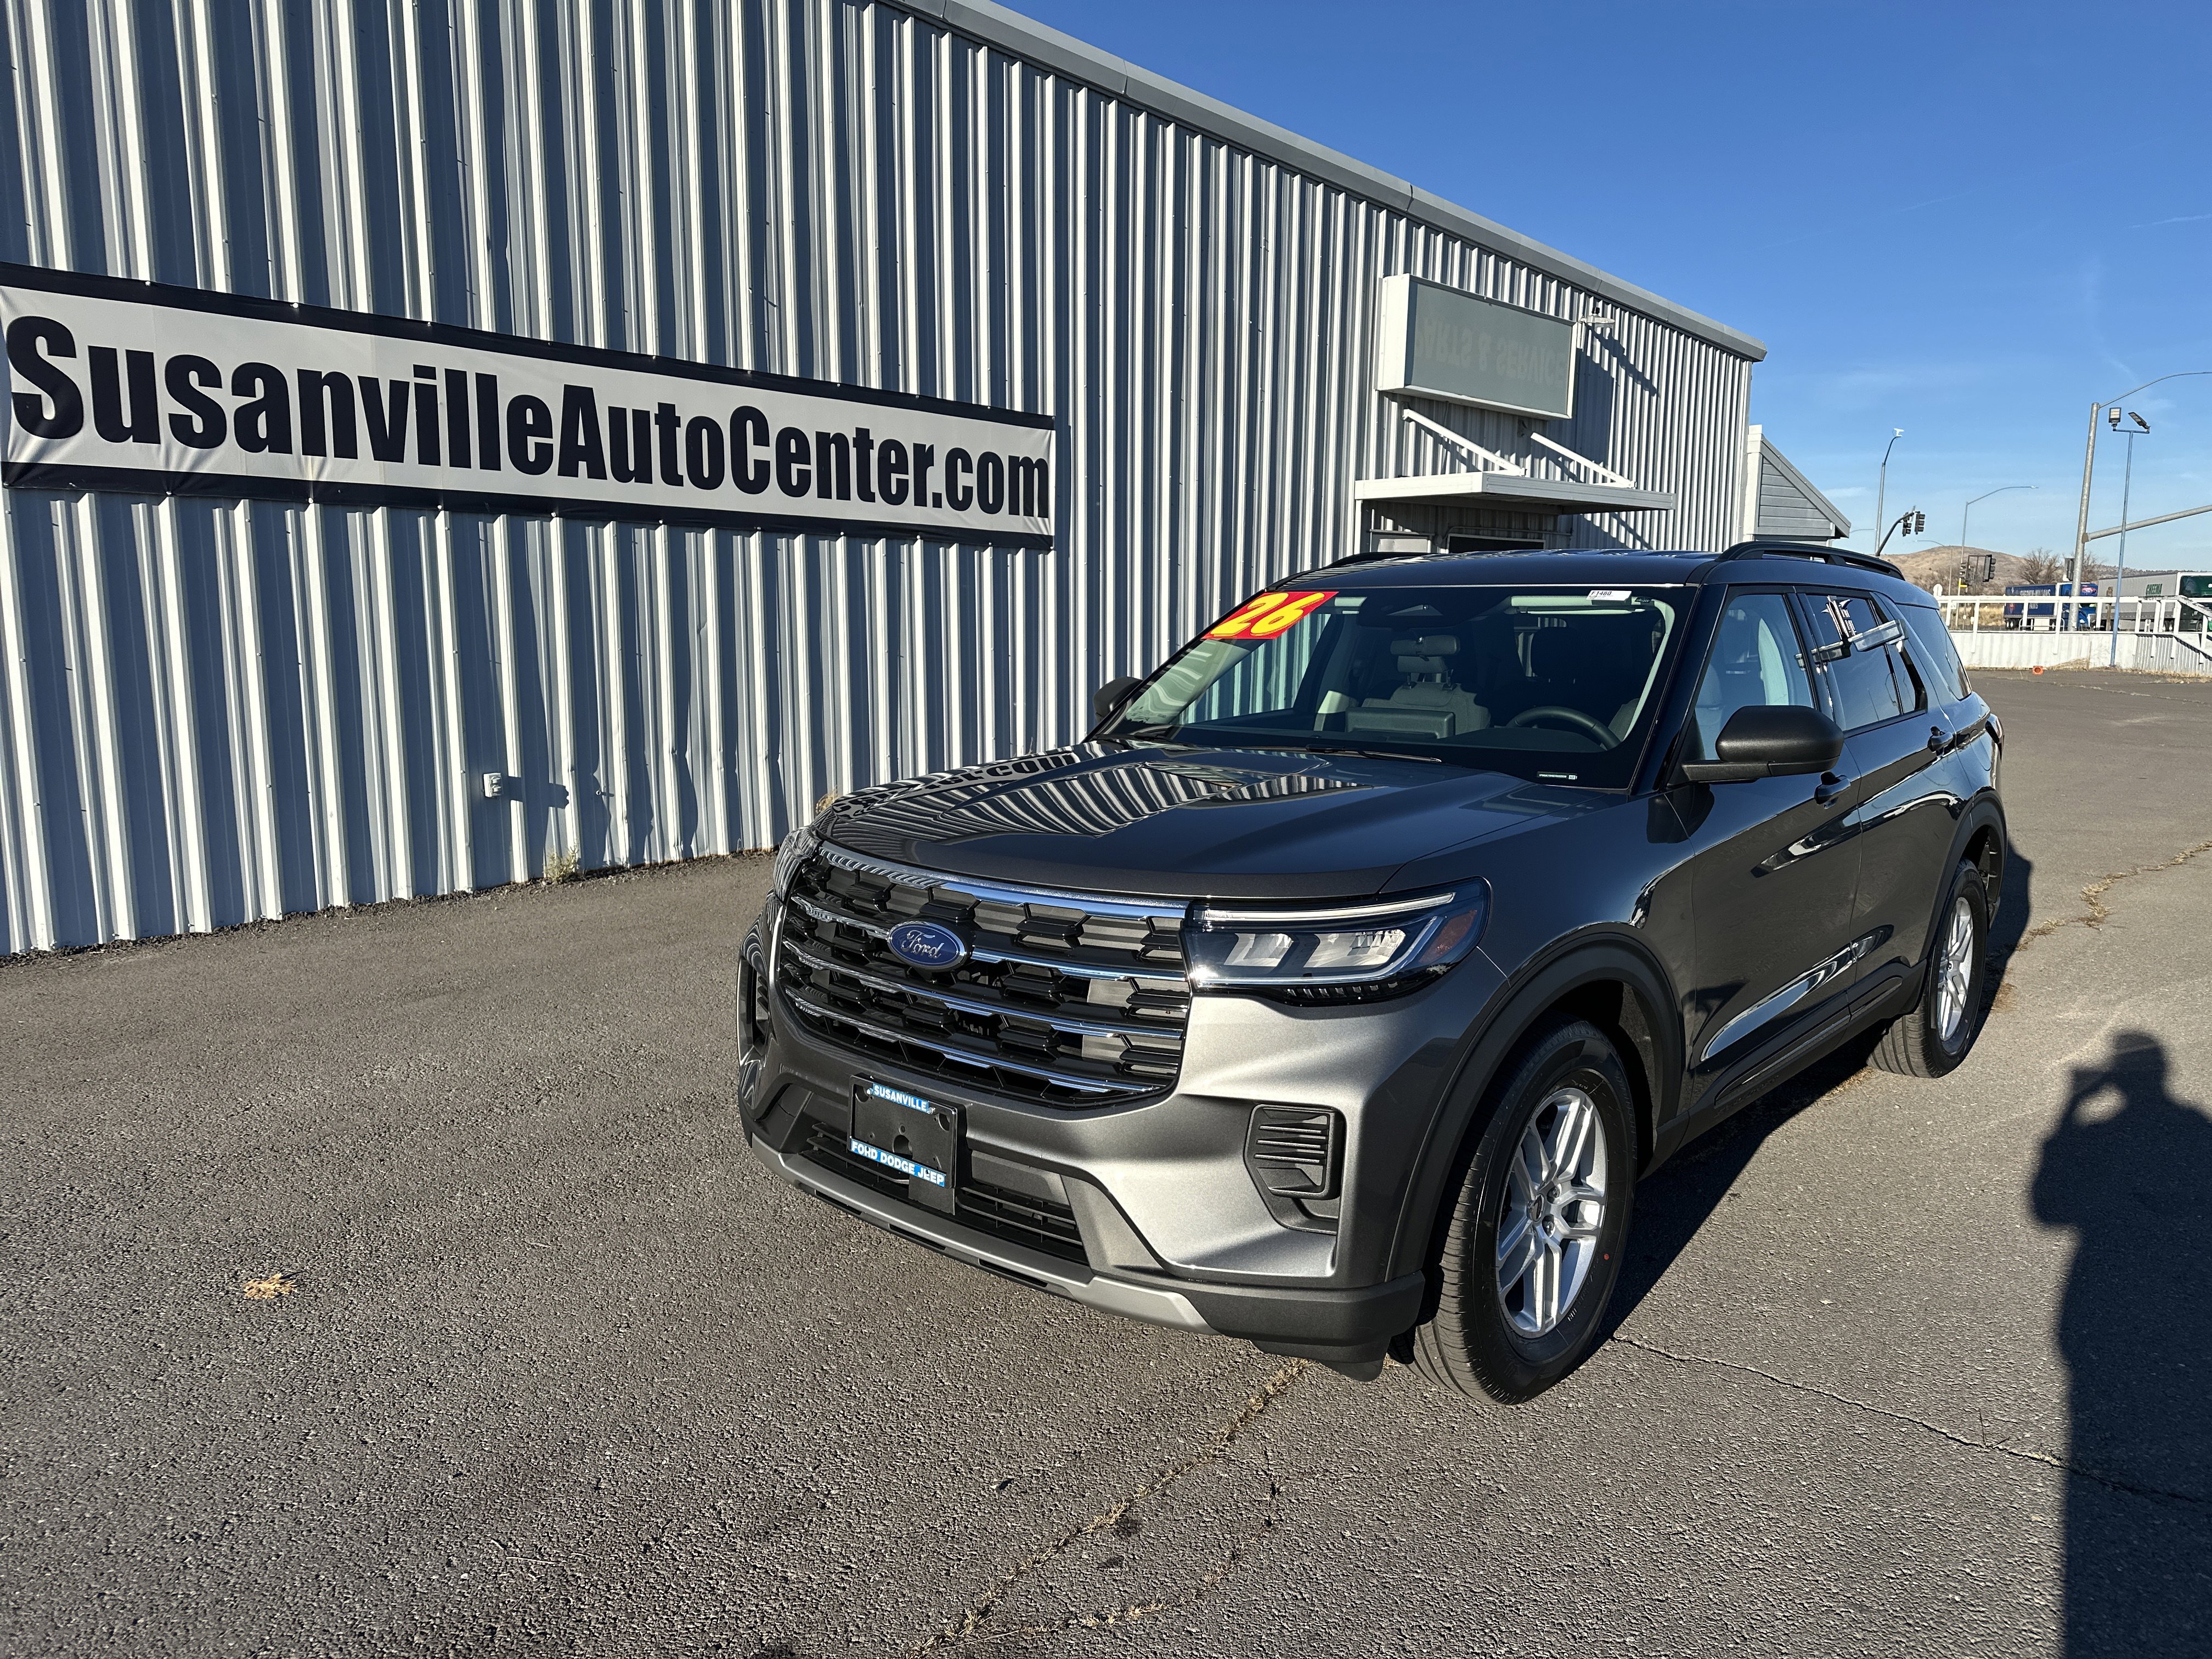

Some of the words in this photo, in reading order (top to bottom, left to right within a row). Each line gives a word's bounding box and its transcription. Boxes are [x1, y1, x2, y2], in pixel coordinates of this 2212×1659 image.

[5, 315, 1048, 518] SusanvilleAutoCenter.com
[1210, 592, 1325, 636] 26
[900, 930, 945, 959] Ford
[873, 1085, 927, 1111] SUSANVILLE
[851, 1141, 878, 1160] FORD
[880, 1155, 915, 1175] DODGE
[918, 1167, 945, 1186] JEEP
